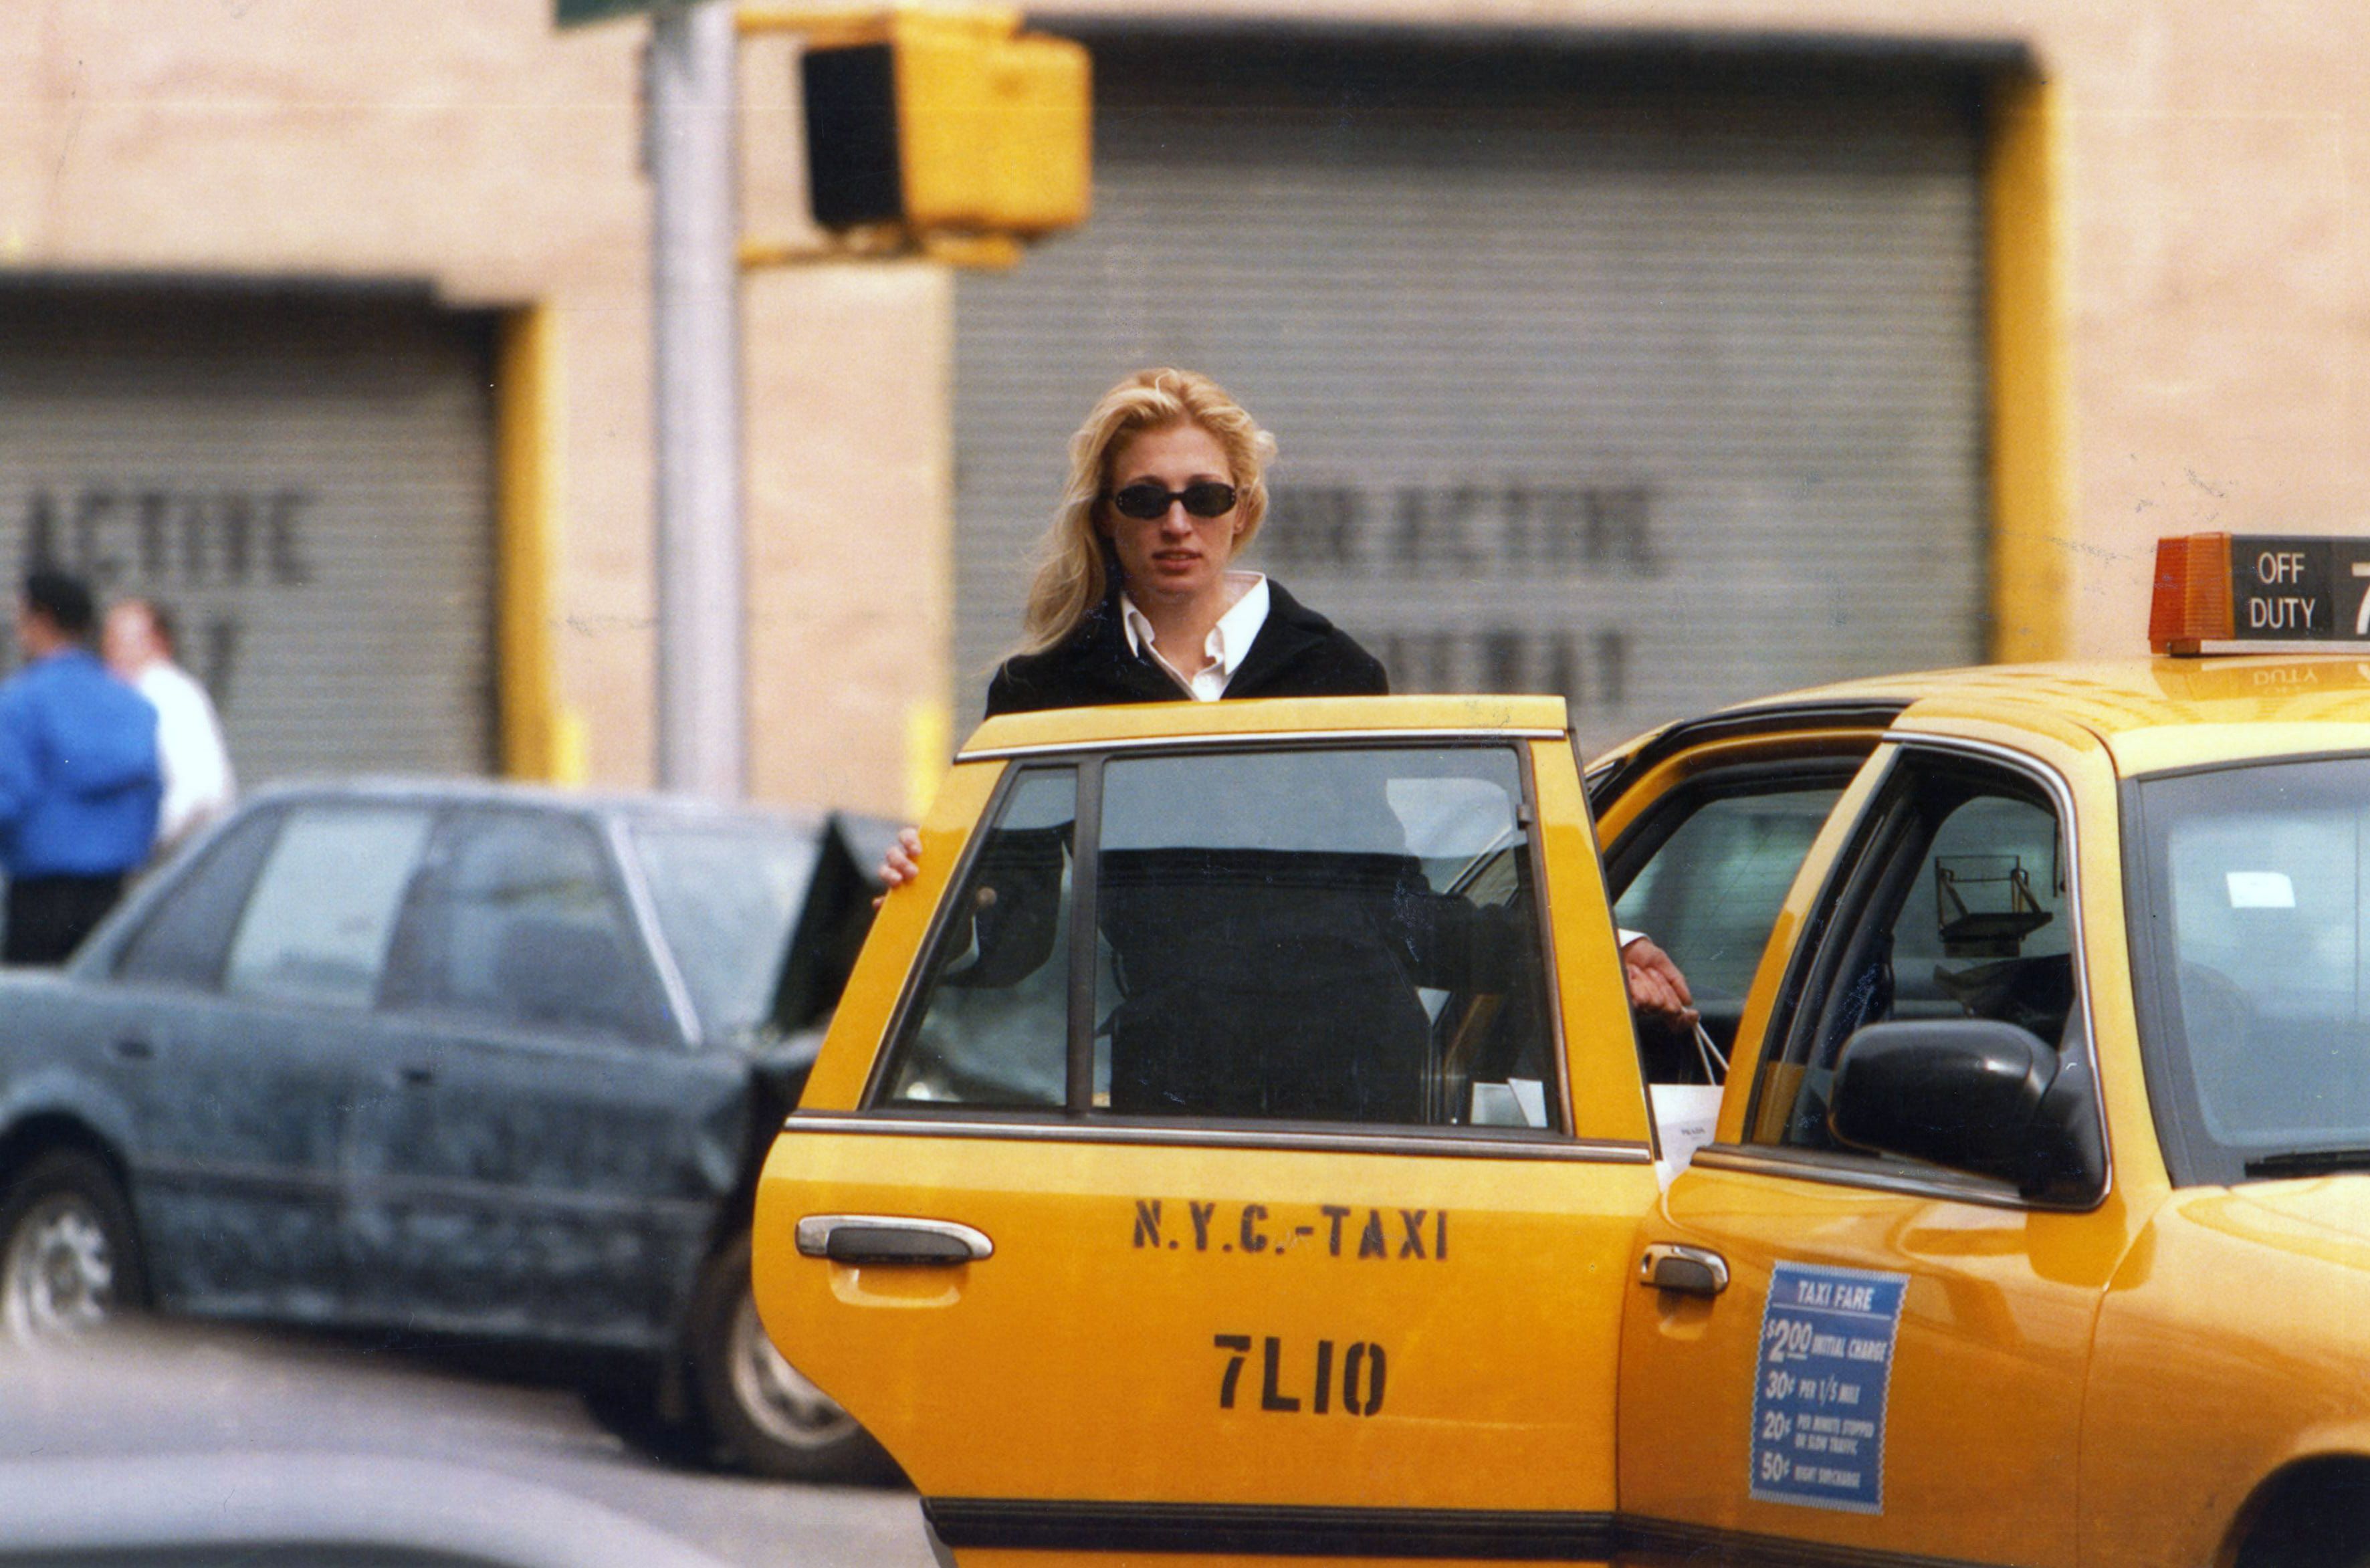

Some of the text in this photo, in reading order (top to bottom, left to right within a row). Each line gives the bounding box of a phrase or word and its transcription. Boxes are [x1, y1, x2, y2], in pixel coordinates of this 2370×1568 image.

[2258, 552, 2306, 584] OFF
[2249, 597, 2317, 629] DUTY
[1798, 1280, 1874, 1312] TAXI FARE
[1848, 1339, 1888, 1363] CHARGE
[1214, 1334, 1386, 1416] 7L10
[1798, 1379, 1817, 1399] PER
[1818, 1373, 1838, 1406] 1/5
